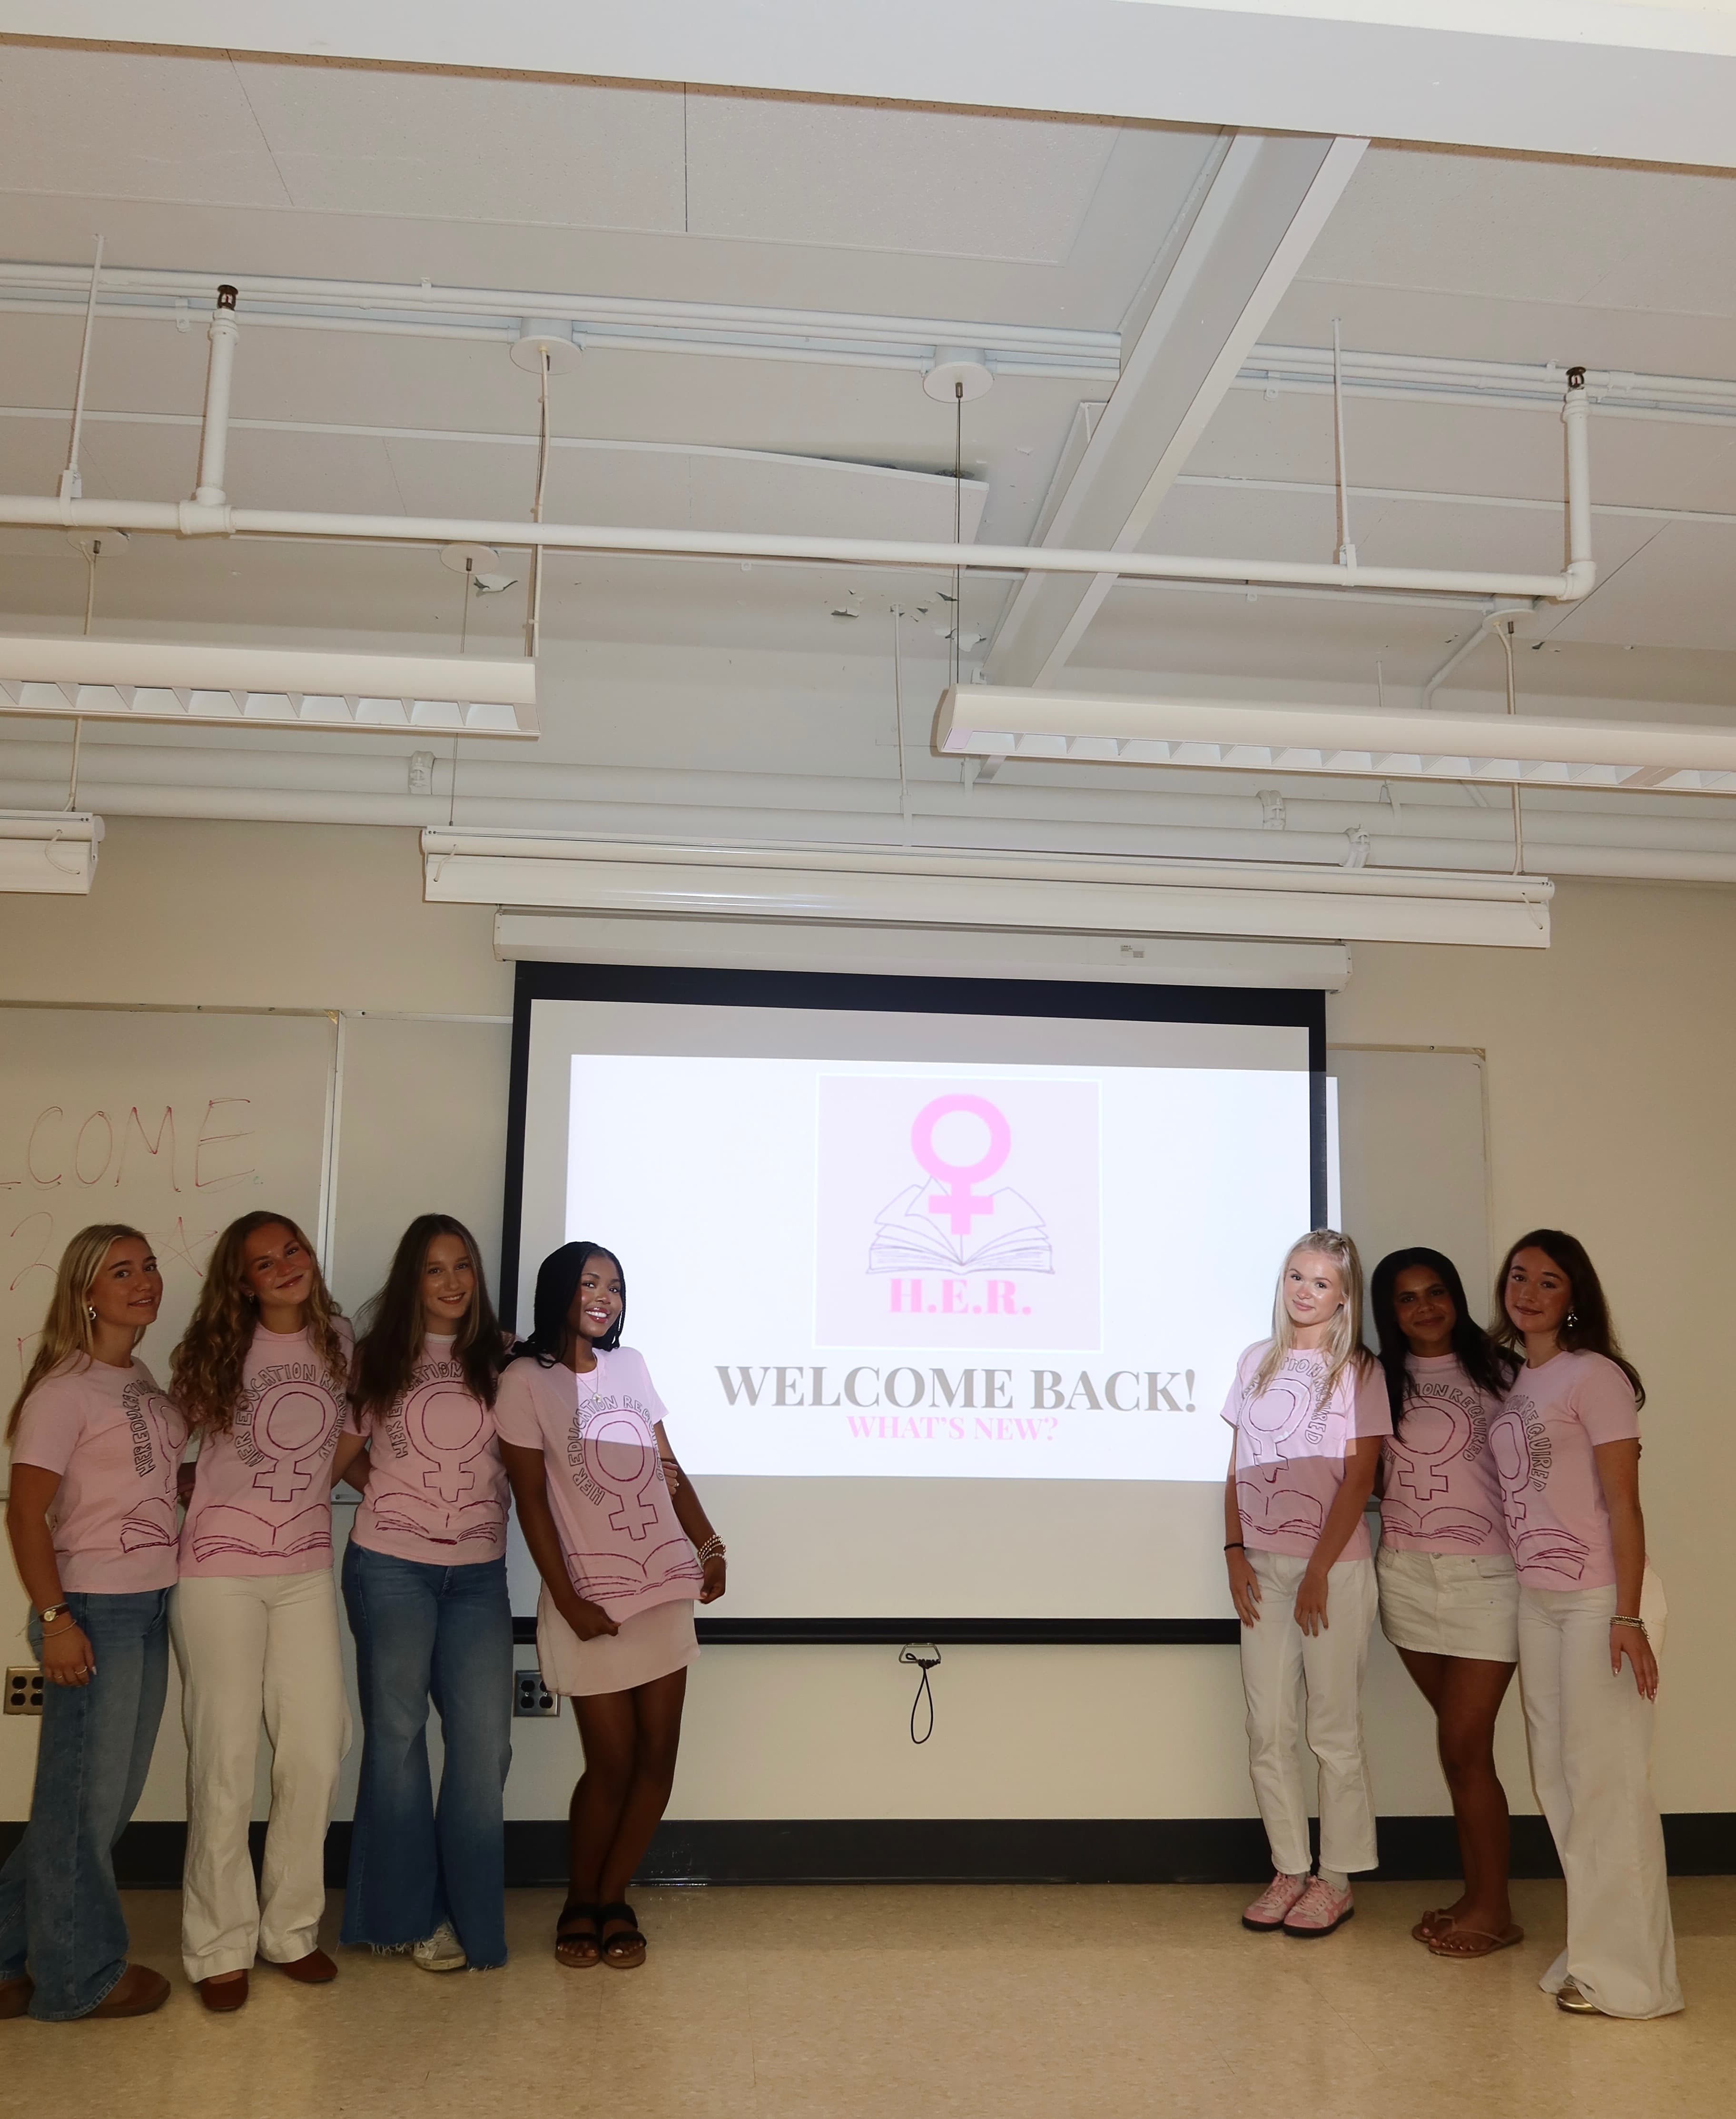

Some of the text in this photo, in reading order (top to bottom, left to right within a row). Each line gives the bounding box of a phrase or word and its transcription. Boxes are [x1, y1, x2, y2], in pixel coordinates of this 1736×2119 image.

[889, 1278, 1032, 1315] H.E.R.
[236, 1362, 316, 1426] EDUCATION
[715, 1365, 1013, 1409] WELCOME
[1030, 1369, 1196, 1413] BACK!
[384, 1419, 409, 1459] HER
[567, 1395, 618, 1467] EDUCATION
[846, 1415, 1058, 1441] WHAT'S NEW?
[1443, 1388, 1487, 1462] REQUIRED
[133, 1442, 157, 1478] HER
[235, 1431, 265, 1468] HER
[1522, 1400, 1552, 1492] REQUIRED
[572, 1468, 606, 1506] HER
